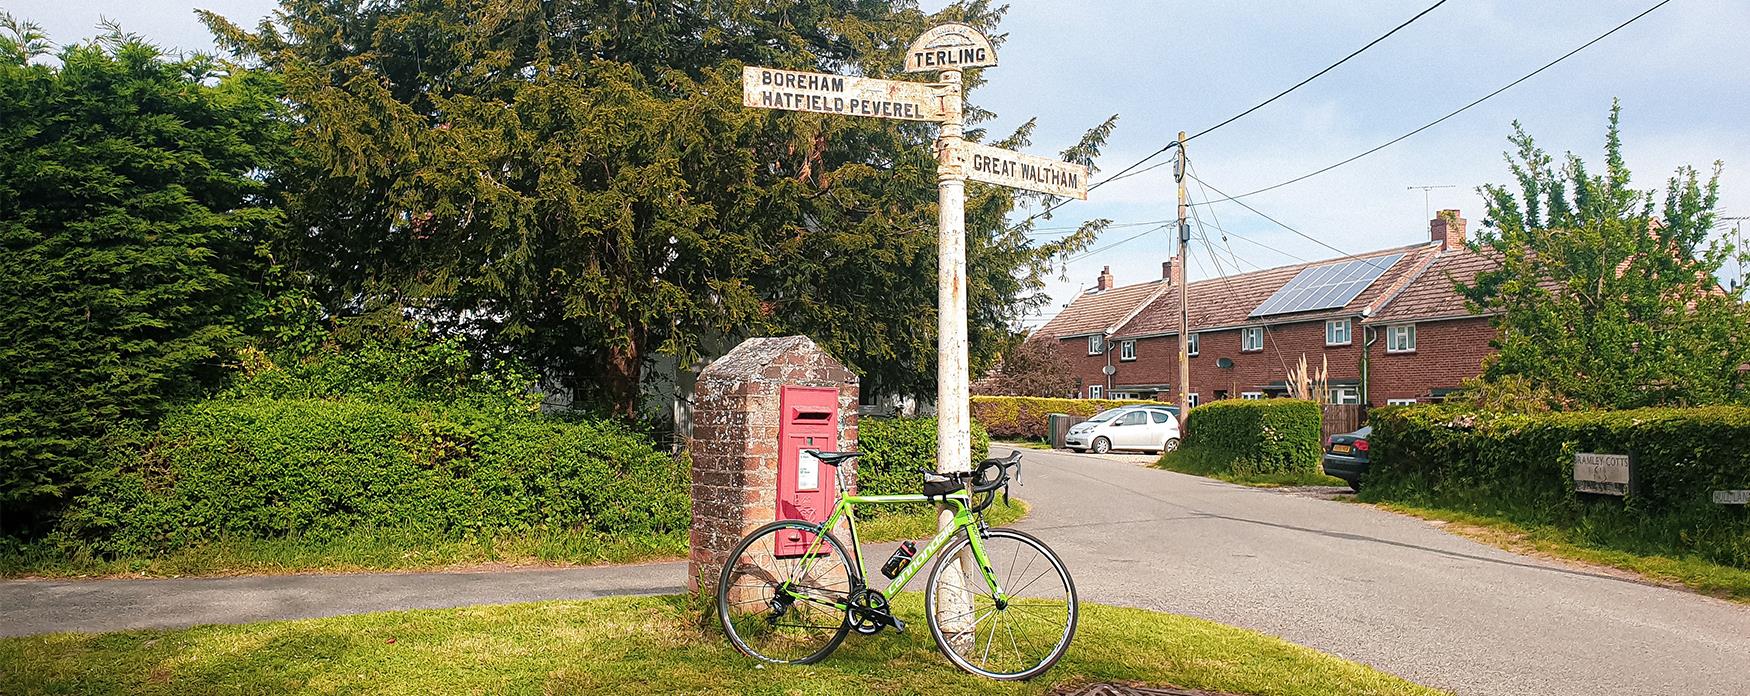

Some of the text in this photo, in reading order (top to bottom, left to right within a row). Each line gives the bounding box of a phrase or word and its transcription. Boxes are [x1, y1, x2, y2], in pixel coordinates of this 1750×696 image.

[915, 48, 985, 67] TERLING
[762, 71, 844, 92] BOREHAM
[762, 91, 924, 119] HATFIELD PEVEREL
[973, 154, 1078, 189] GREAT WALTHAM
[1606, 456, 1628, 467] COTTS
[888, 521, 956, 595] cannondale
